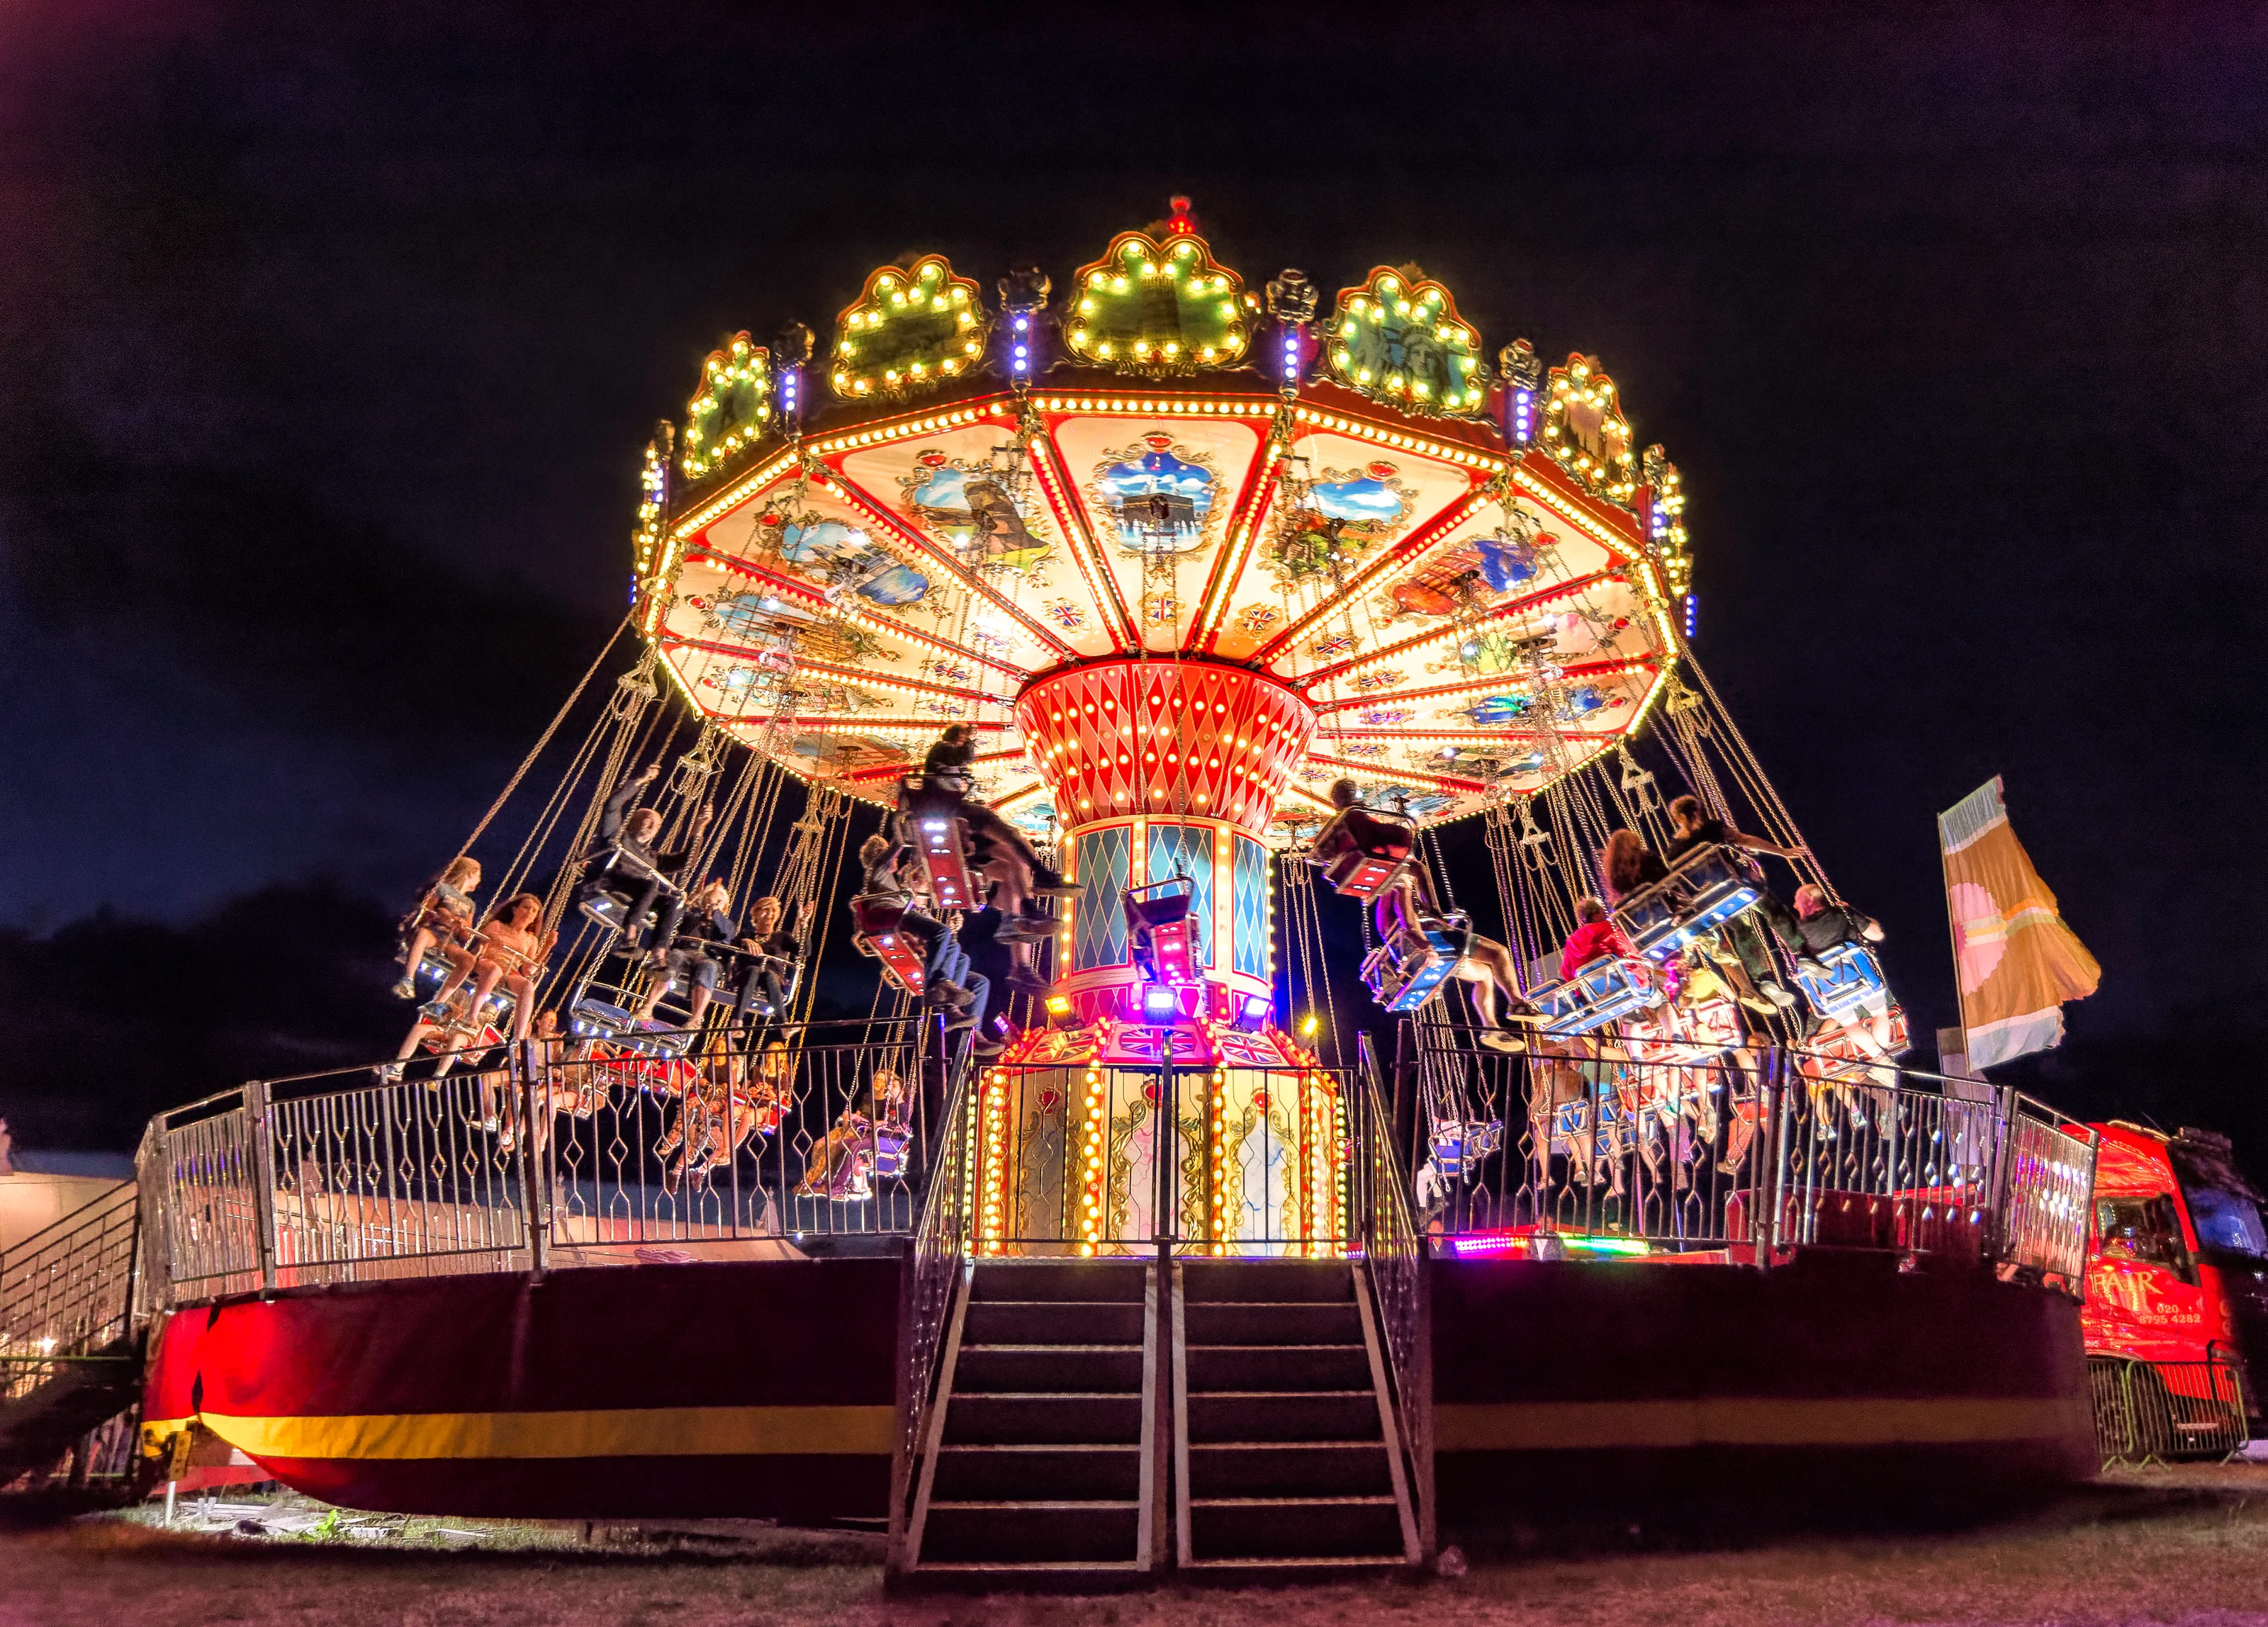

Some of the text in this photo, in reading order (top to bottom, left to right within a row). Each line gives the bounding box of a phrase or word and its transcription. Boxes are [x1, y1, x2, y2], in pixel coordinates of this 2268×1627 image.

[2157, 1303, 2179, 1314] 020
[2139, 1314, 2201, 1324] 8795 4282
